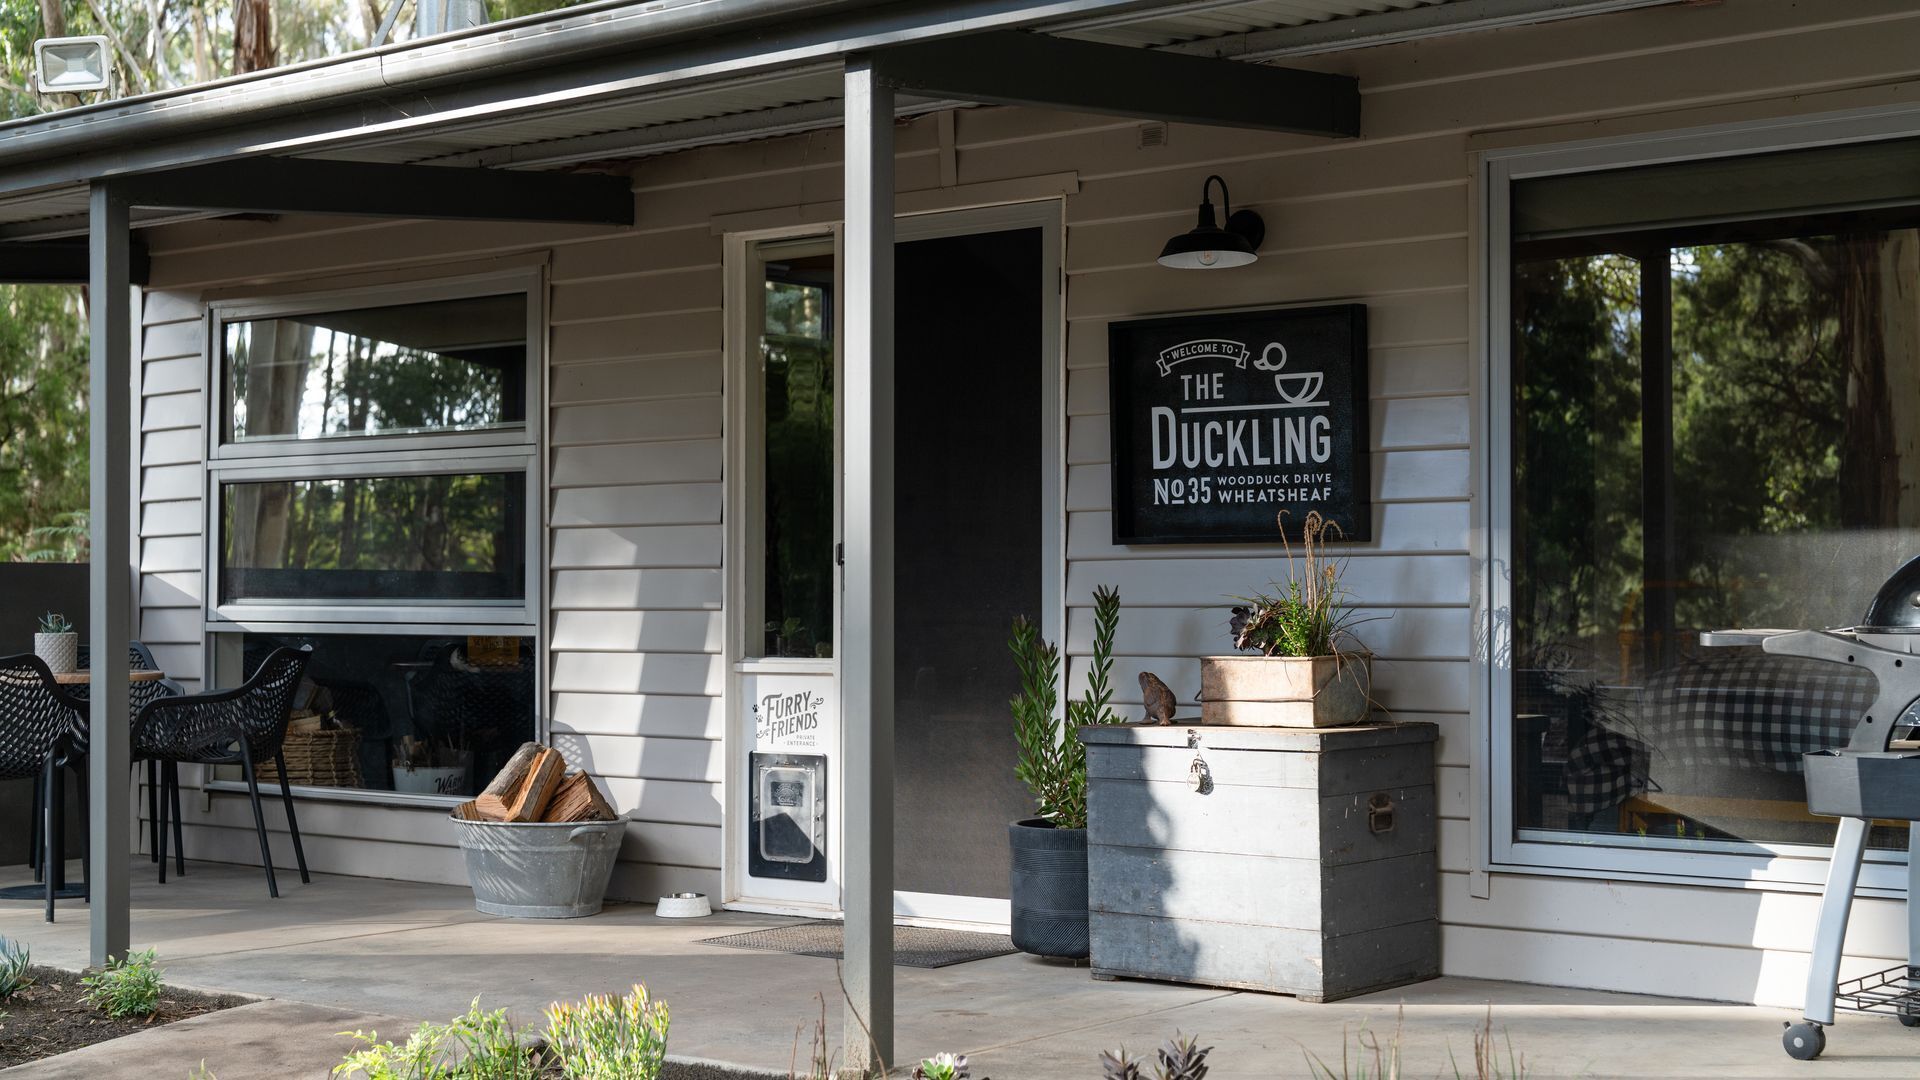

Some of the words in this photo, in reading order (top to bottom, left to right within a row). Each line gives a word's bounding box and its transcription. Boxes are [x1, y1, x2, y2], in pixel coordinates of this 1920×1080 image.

[1171, 343, 1218, 360] WELCOME
[1221, 343, 1234, 354] TO
[1180, 373, 1225, 401] THE
[1151, 406, 1331, 470] DUCKLING
[1217, 474, 1289, 486] WOODDUCK
[1294, 473, 1332, 484] DRIVE
[1217, 487, 1332, 504] WHEATSHEAF
[761, 690, 812, 727] FURRY
[770, 711, 818, 745] FRIENDS
